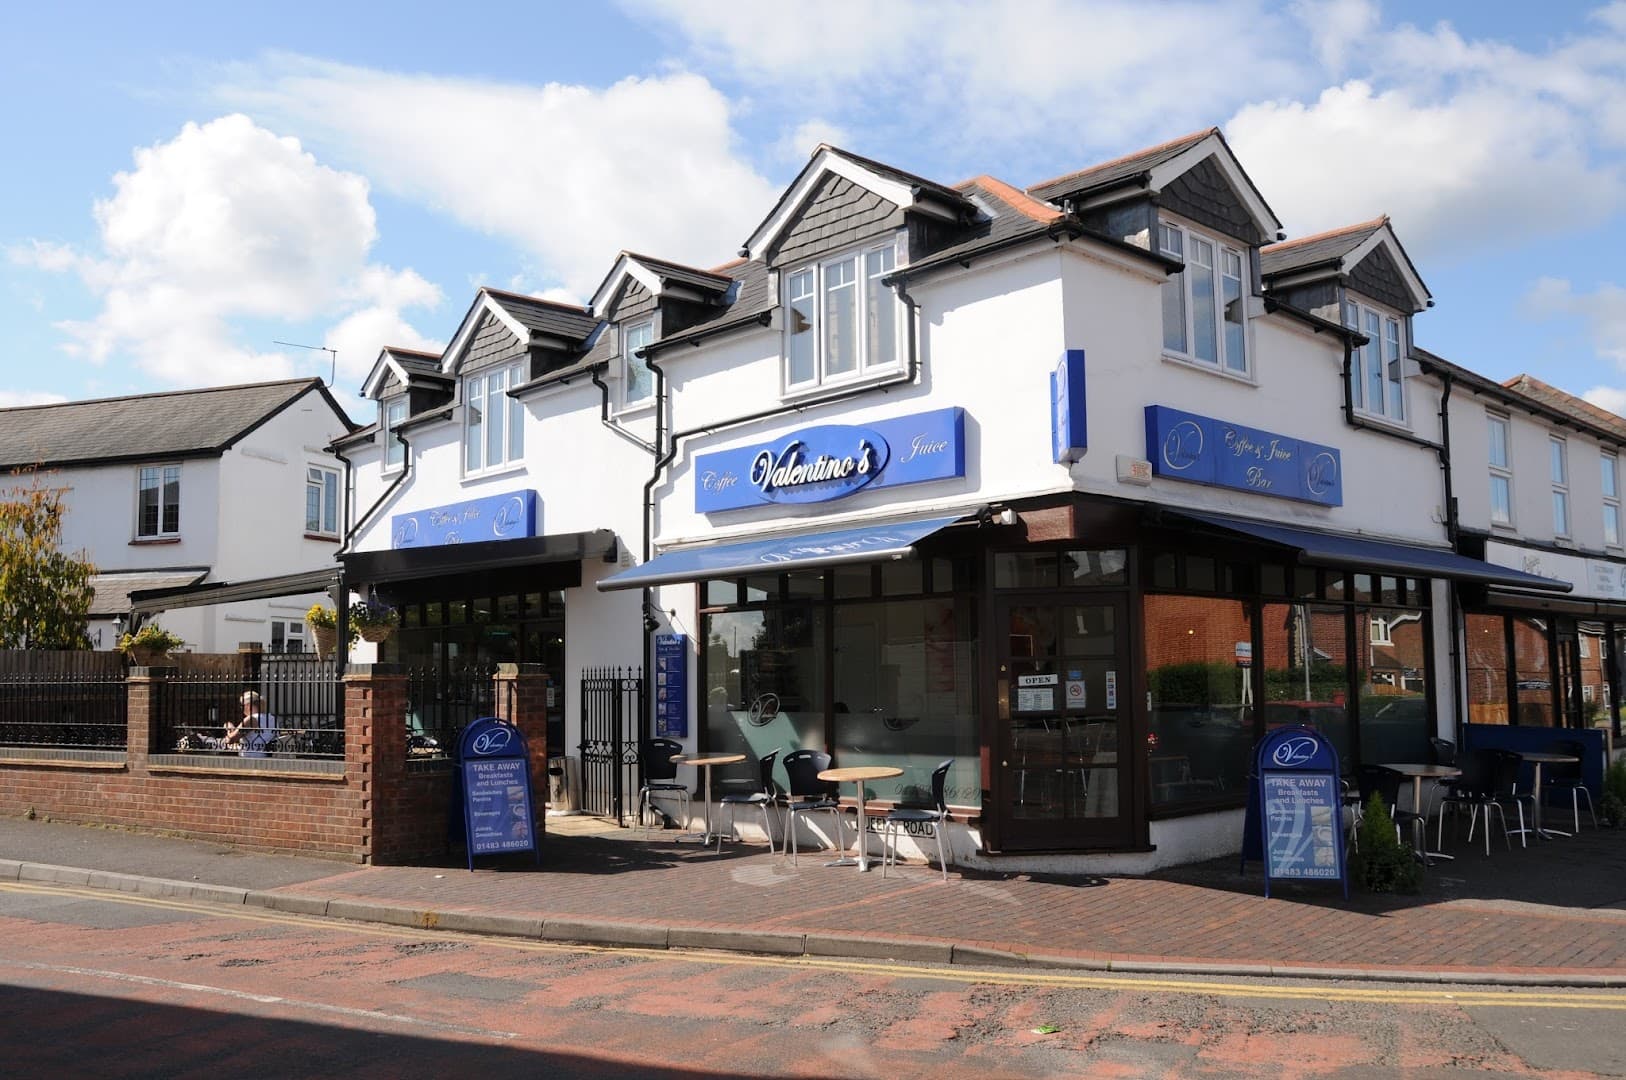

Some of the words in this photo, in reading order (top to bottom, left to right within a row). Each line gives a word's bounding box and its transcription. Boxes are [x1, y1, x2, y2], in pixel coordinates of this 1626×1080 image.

[1224, 428, 1253, 456] Coffee
[1264, 440, 1292, 461] Juice
[702, 470, 738, 497] Coffee
[750, 438, 871, 493] Valentino's
[901, 432, 948, 463] Juice
[1246, 466, 1273, 489] Bar
[1025, 676, 1052, 685] OPEN
[473, 764, 495, 772] TAKE
[497, 762, 520, 771] AWAY
[479, 772, 513, 780] Breakfasts
[1271, 778, 1297, 787] TAKE
[1298, 778, 1327, 787] AWAY
[903, 819, 934, 836] ROAD
[477, 842, 500, 850] 01483
